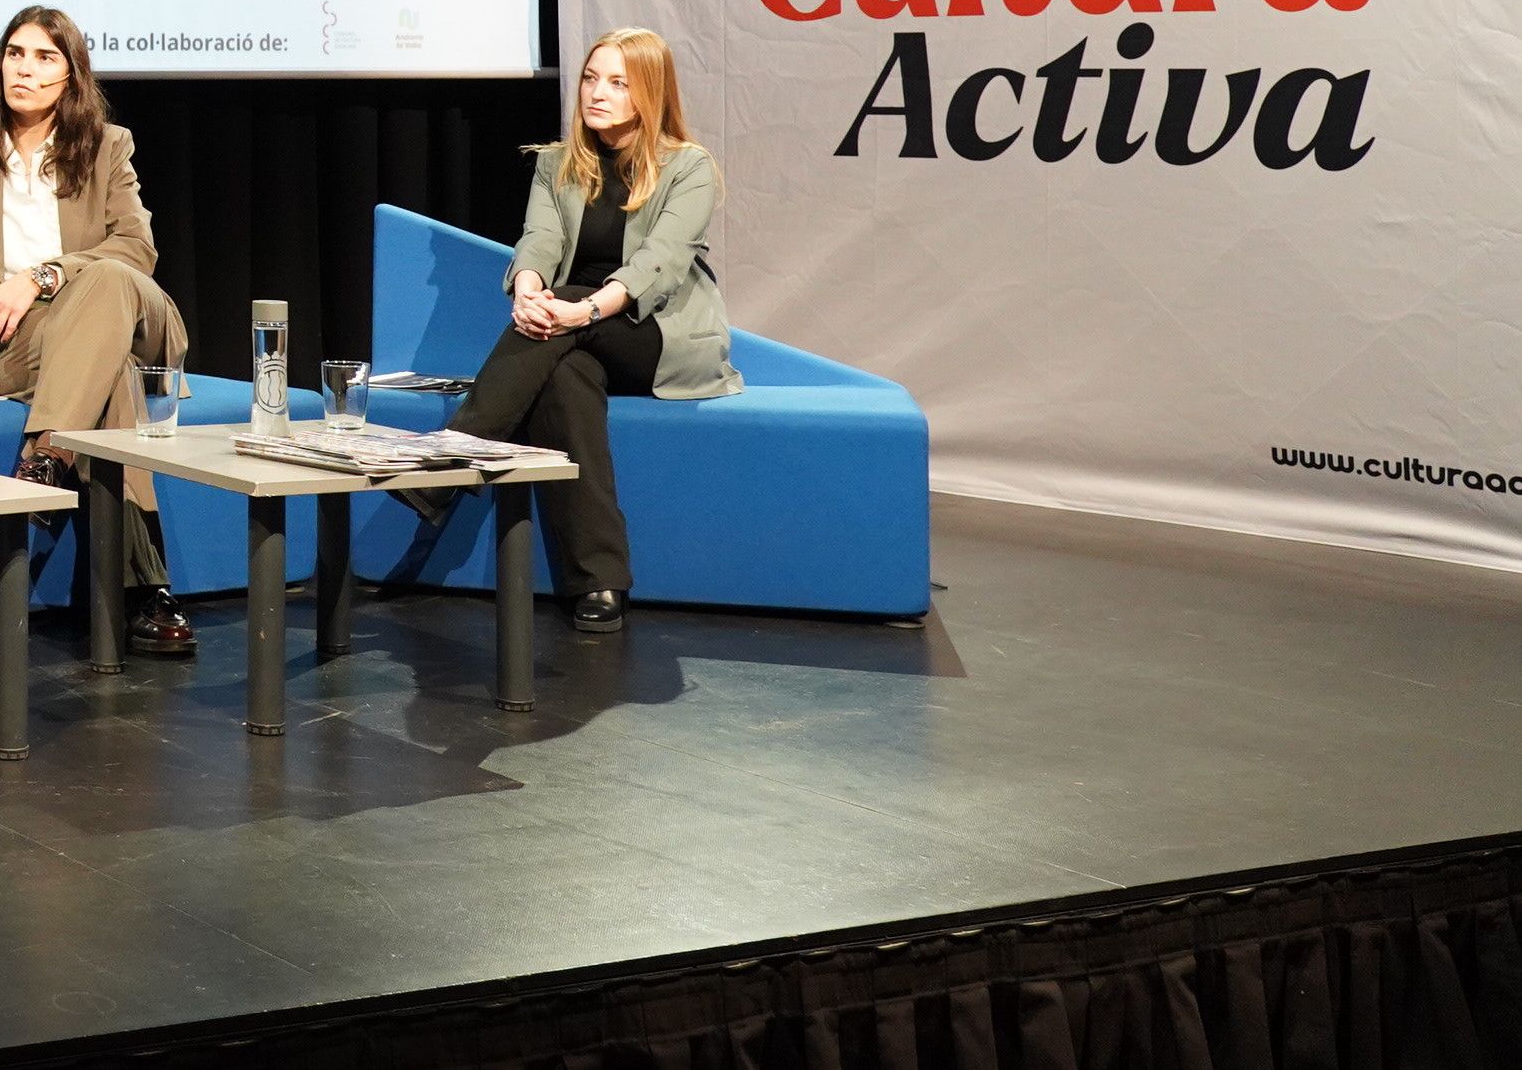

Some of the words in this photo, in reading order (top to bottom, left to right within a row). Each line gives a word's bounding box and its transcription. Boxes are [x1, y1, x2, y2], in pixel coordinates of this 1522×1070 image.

[103, 33, 119, 51] la
[259, 33, 288, 52] de:
[833, 21, 1376, 172] Activa
